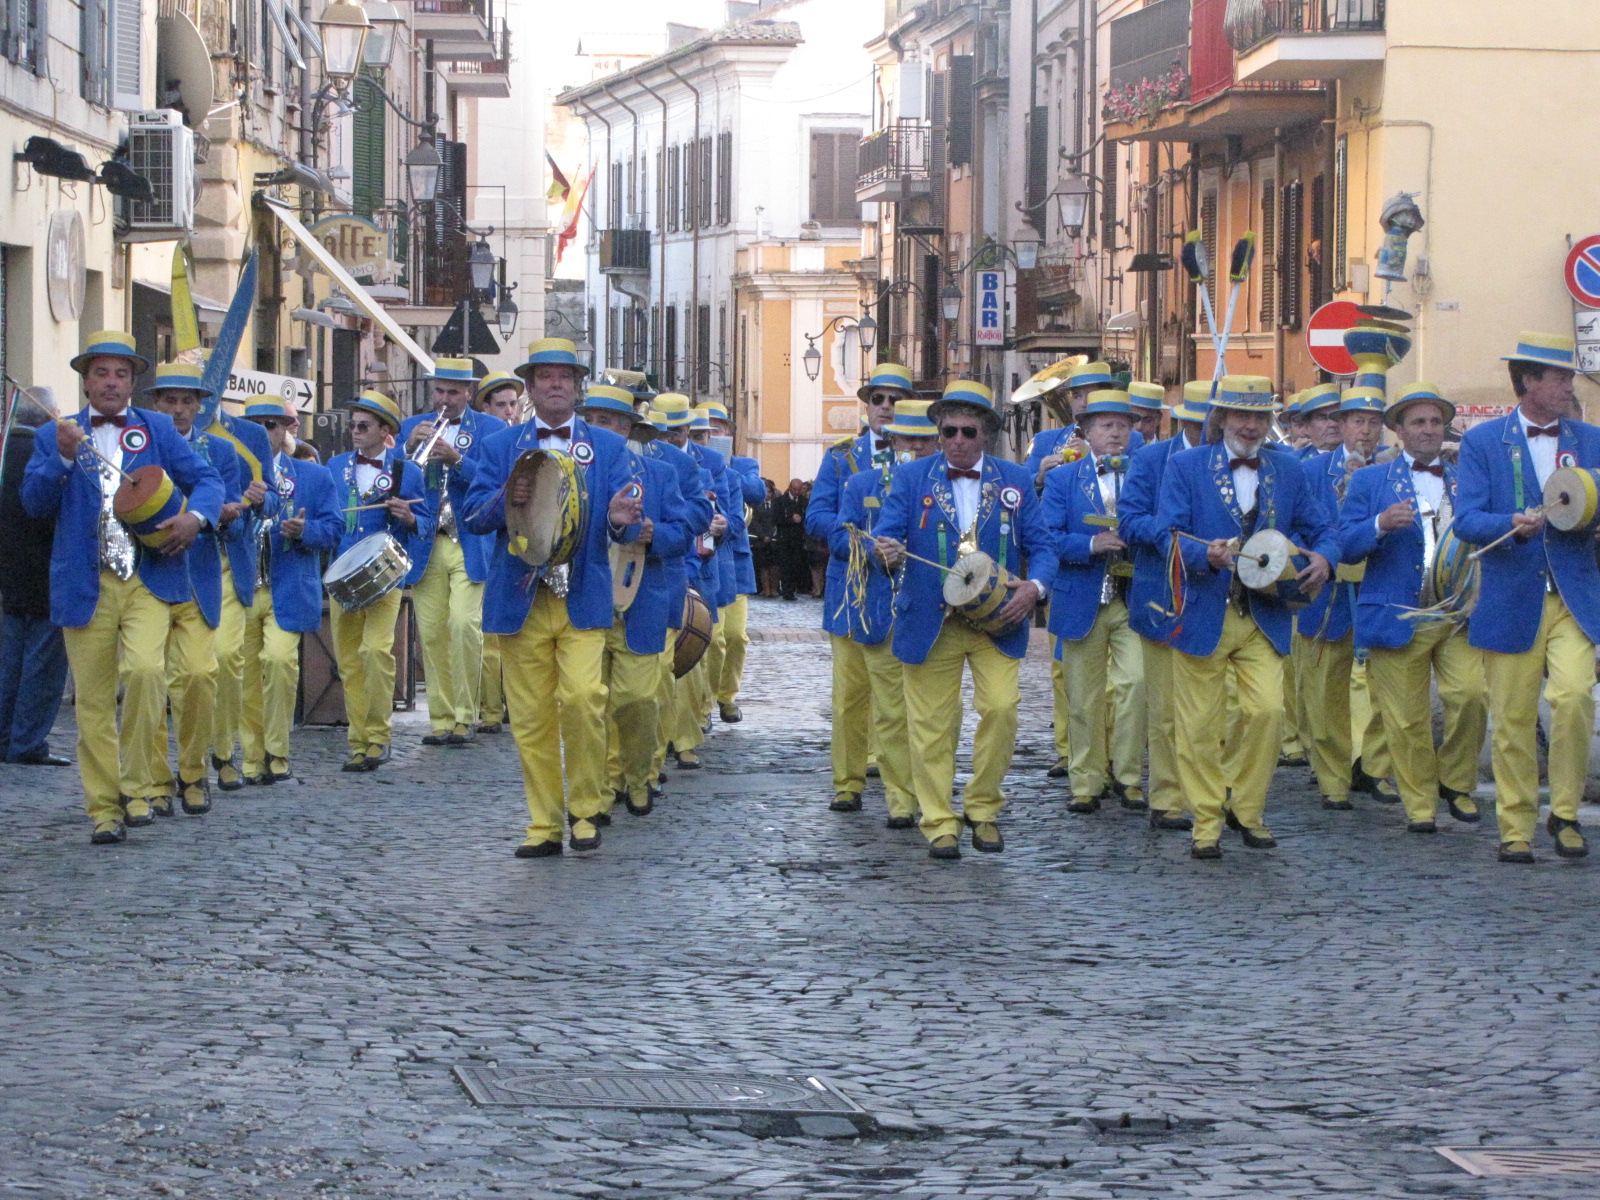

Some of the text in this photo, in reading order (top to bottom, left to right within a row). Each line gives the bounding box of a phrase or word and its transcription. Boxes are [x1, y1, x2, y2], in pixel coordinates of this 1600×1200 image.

[313, 224, 382, 262] AFFE'
[982, 273, 998, 328] BAR
[225, 376, 266, 395] BANO
